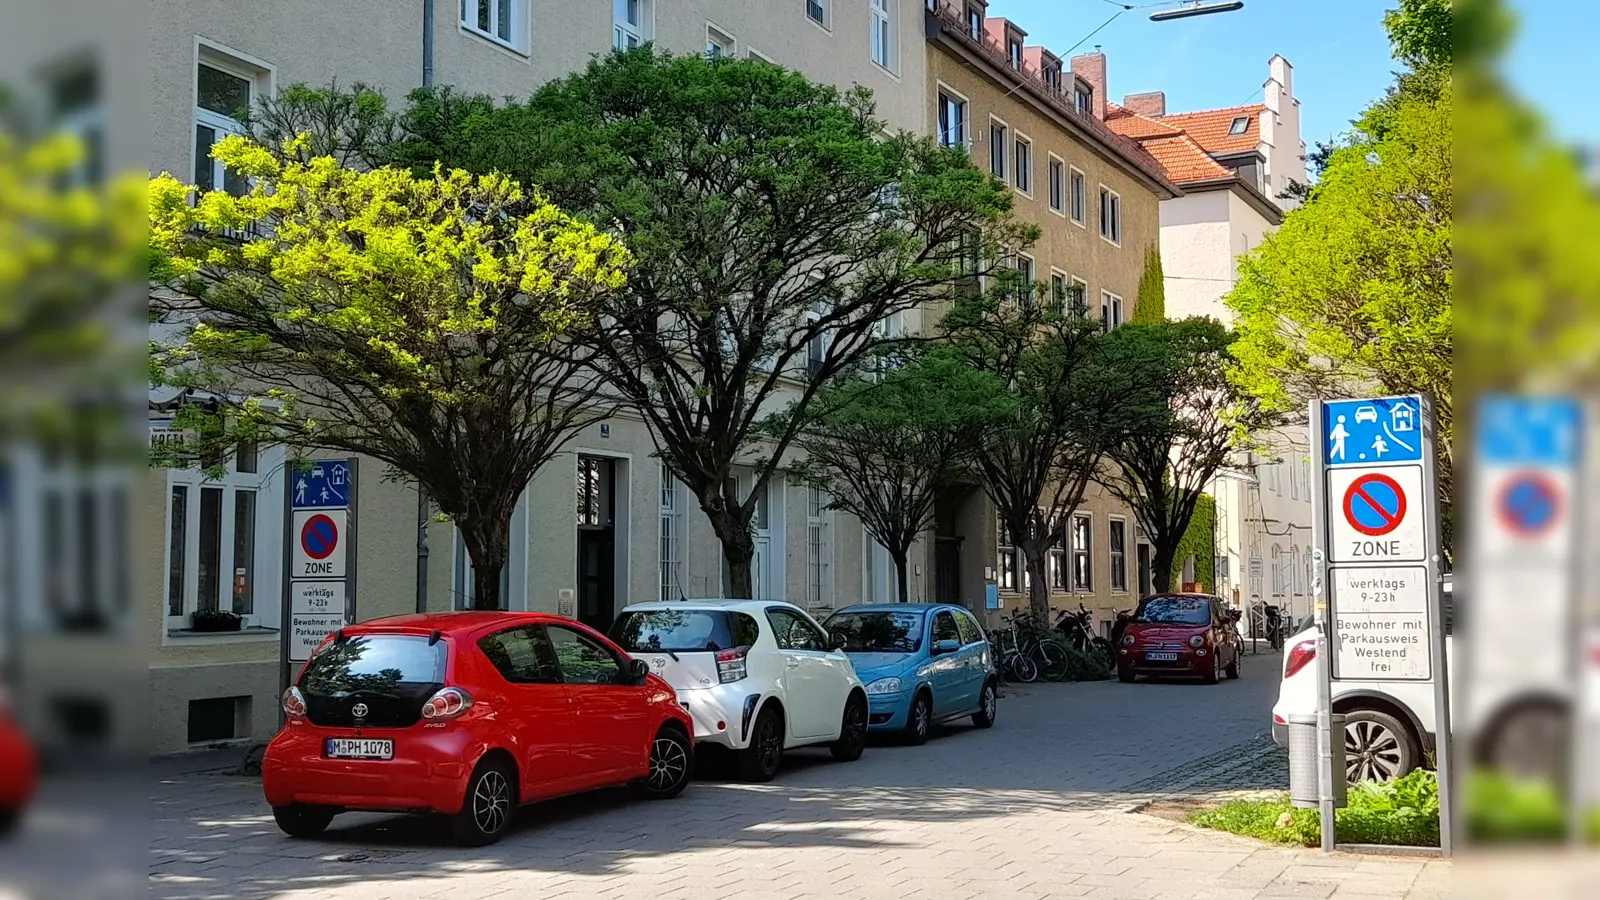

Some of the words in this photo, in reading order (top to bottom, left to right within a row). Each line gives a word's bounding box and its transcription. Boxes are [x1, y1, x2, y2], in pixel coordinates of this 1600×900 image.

[1352, 541, 1400, 556] ZONE
[305, 563, 333, 574] ZONE
[1350, 578, 1405, 590] werktags
[302, 588, 334, 598] werktags
[293, 618, 328, 626] Bewohner
[1336, 619, 1396, 630] Bewohner
[1403, 619, 1422, 629] mit
[1341, 633, 1418, 644] Parkausweis
[1355, 647, 1406, 658] Westend
[1371, 661, 1391, 672] frei
[333, 741, 340, 753] M
[348, 741, 361, 753] PH
[364, 741, 391, 754] 1078
